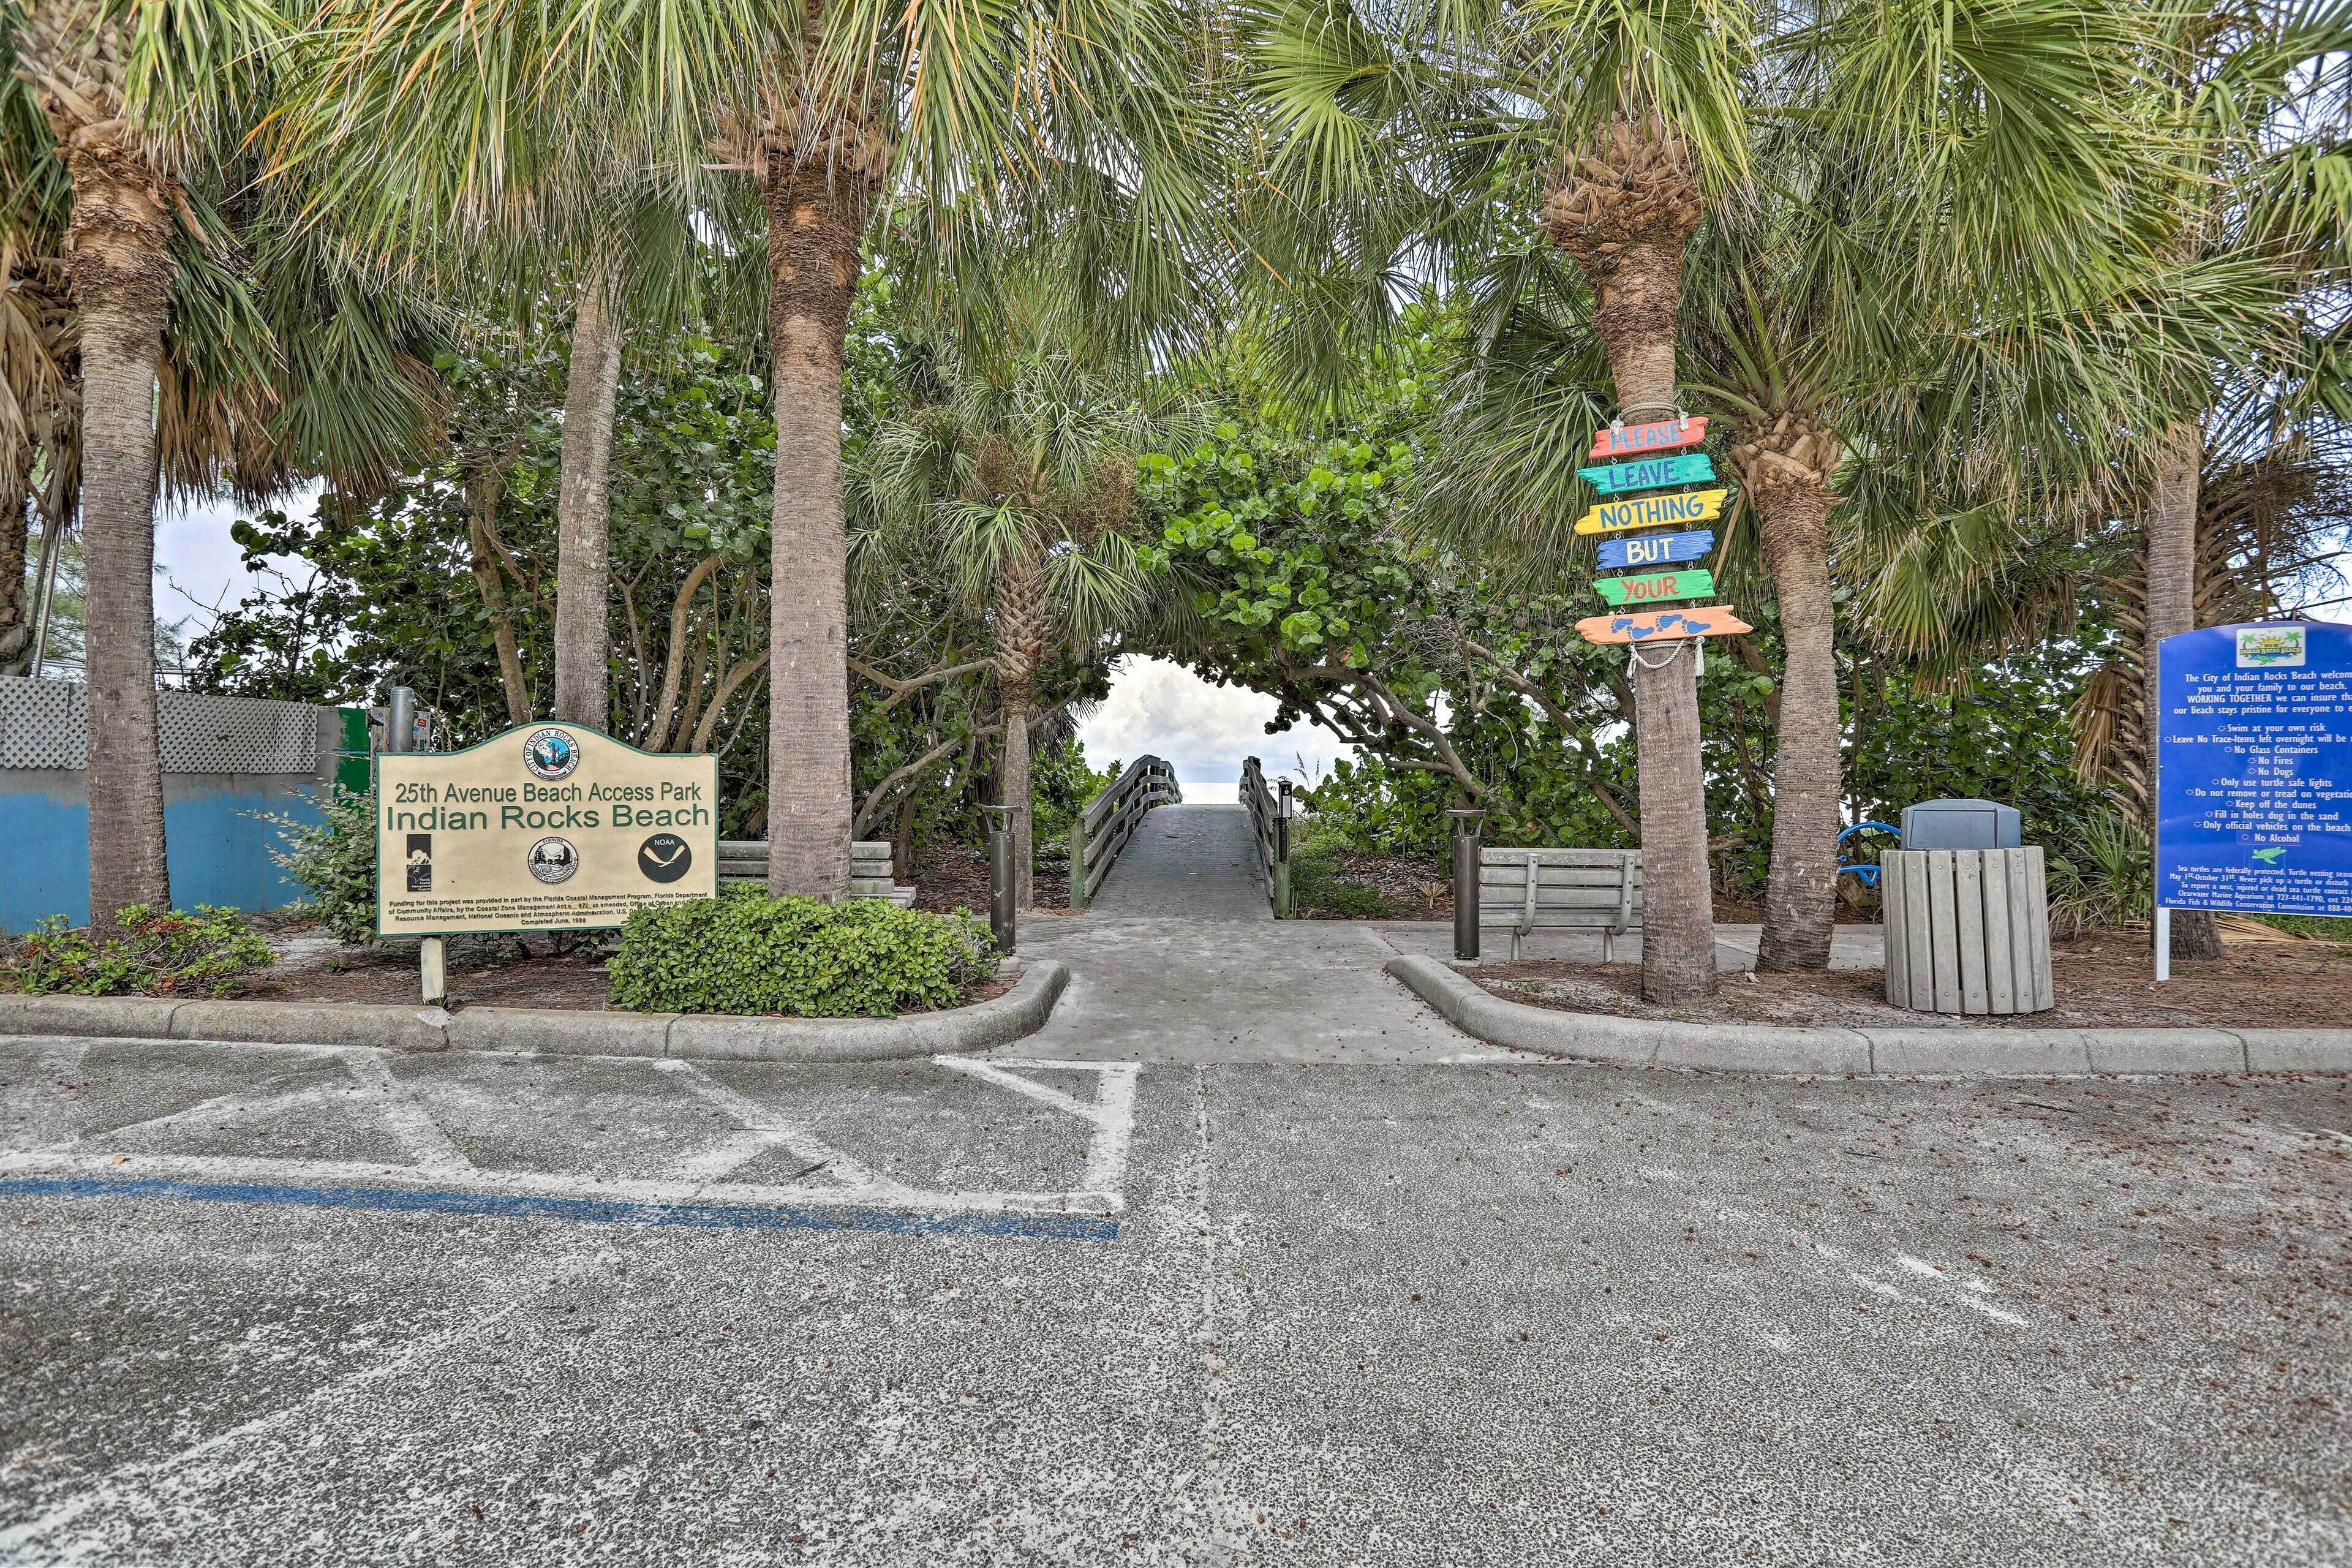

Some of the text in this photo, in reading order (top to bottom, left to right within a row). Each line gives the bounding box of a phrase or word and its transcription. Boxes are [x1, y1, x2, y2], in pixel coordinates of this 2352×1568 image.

[1610, 423, 1684, 451] PLEASE
[1609, 459, 1680, 489] LEAVE
[1600, 494, 1704, 529] NOTHING
[1626, 537, 1673, 564] BUT
[1620, 576, 1680, 603] YOUR
[2185, 674, 2199, 682] The
[2203, 673, 2218, 684] City
[2234, 673, 2260, 681] Indian
[2264, 672, 2287, 680] Rocks
[2291, 671, 2316, 680] Beach
[2198, 686, 2212, 695] you
[2235, 685, 2254, 694] your
[2258, 682, 2283, 692] family
[2319, 681, 2347, 690] beach.
[2187, 695, 2226, 703] WORKING
[2229, 693, 2271, 703] TOGETHER
[2311, 693, 2337, 701] insure
[2191, 706, 2214, 714] beach
[2218, 707, 2237, 715] stays
[2242, 704, 2272, 716] pristine
[2292, 706, 2331, 715] everyone
[2265, 725, 2285, 734] your
[2310, 723, 2326, 731] risk
[2212, 734, 2255, 743] Trace-Items
[2259, 734, 2272, 743] left
[2275, 734, 2314, 745] overnight
[2317, 734, 2332, 742] will
[526, 730, 578, 772] CITY OF INDIAN ROCKS BEACH
[2250, 745, 2271, 753] Glass
[2274, 745, 2318, 754] Containers
[2274, 756, 2293, 765] Fires
[2258, 767, 2293, 777] No Dogs
[2221, 777, 2239, 788] Only
[2261, 778, 2283, 787] turtle
[2288, 778, 2305, 787] safe
[2309, 778, 2332, 790] lights
[395, 782, 701, 803] 25th Avenue Beach Access Park
[2275, 790, 2296, 798] tread
[2236, 799, 2255, 810] Keep
[2292, 801, 2316, 809] dunes
[388, 804, 709, 830] Indian Rocks Beach
[2268, 812, 2284, 823] dug
[2288, 812, 2296, 820] in
[2301, 812, 2314, 820] the
[2318, 812, 2339, 821] sand
[2203, 821, 2222, 831] Only
[2225, 821, 2252, 830] official
[2256, 822, 2288, 831] vehicles
[2307, 823, 2321, 831] the
[2325, 823, 2351, 832] beach
[2255, 833, 2299, 843] No Alcohol
